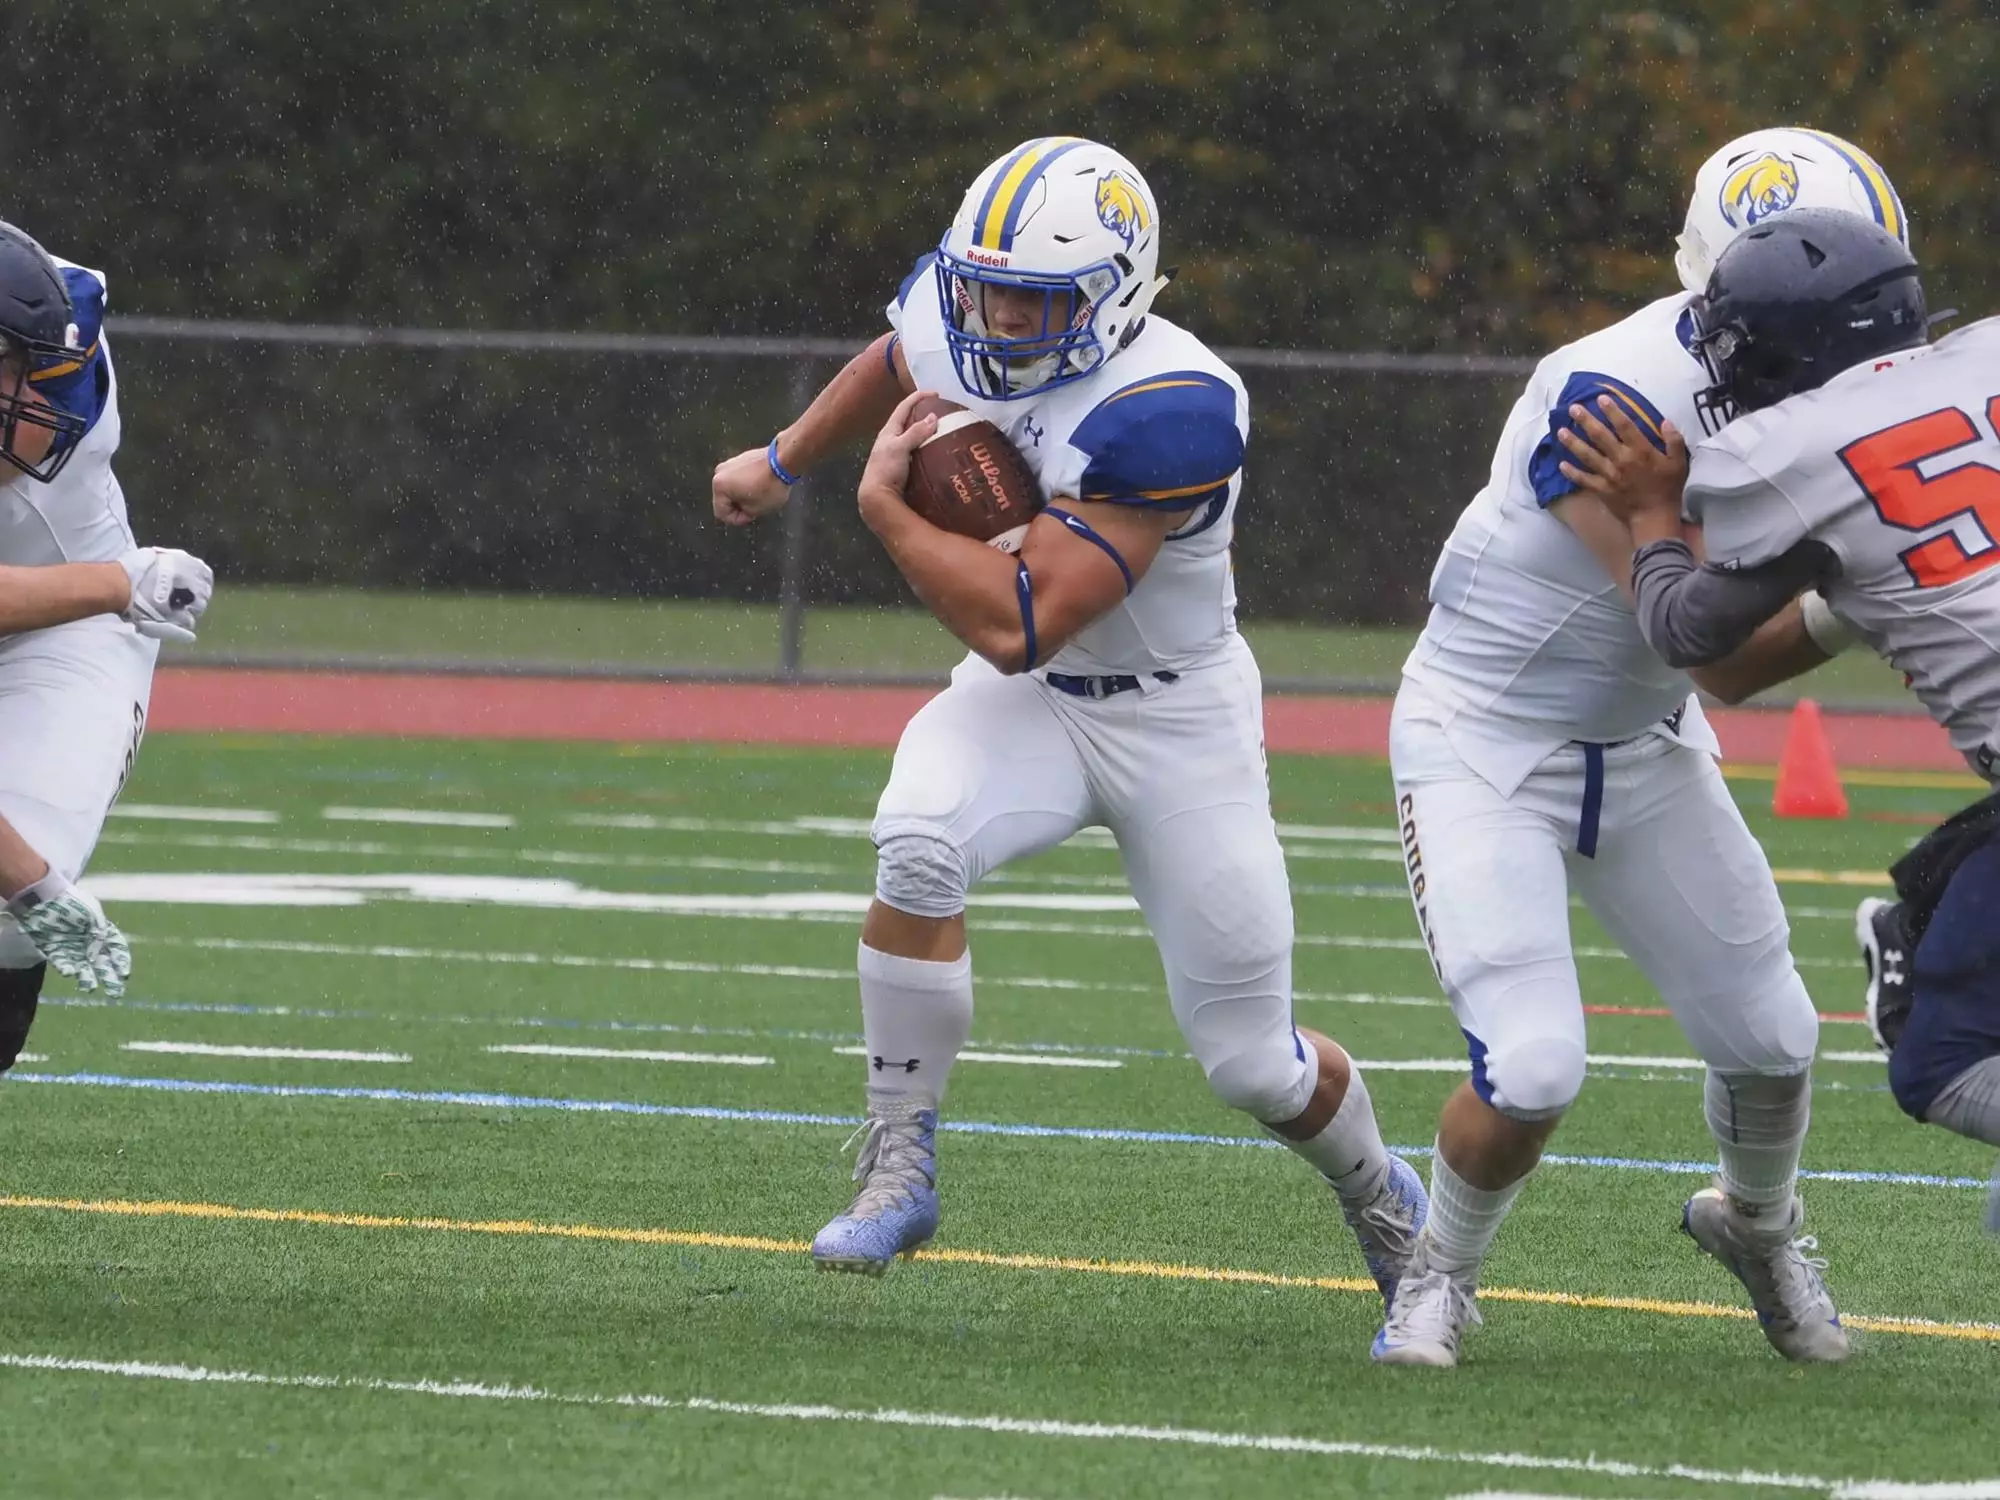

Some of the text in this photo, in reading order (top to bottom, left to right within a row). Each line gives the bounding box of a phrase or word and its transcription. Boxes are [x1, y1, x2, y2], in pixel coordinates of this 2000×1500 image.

[966, 249, 1009, 269] Riddell
[969, 442, 1010, 512] Wilson
[1835, 394, 2000, 589] 5
